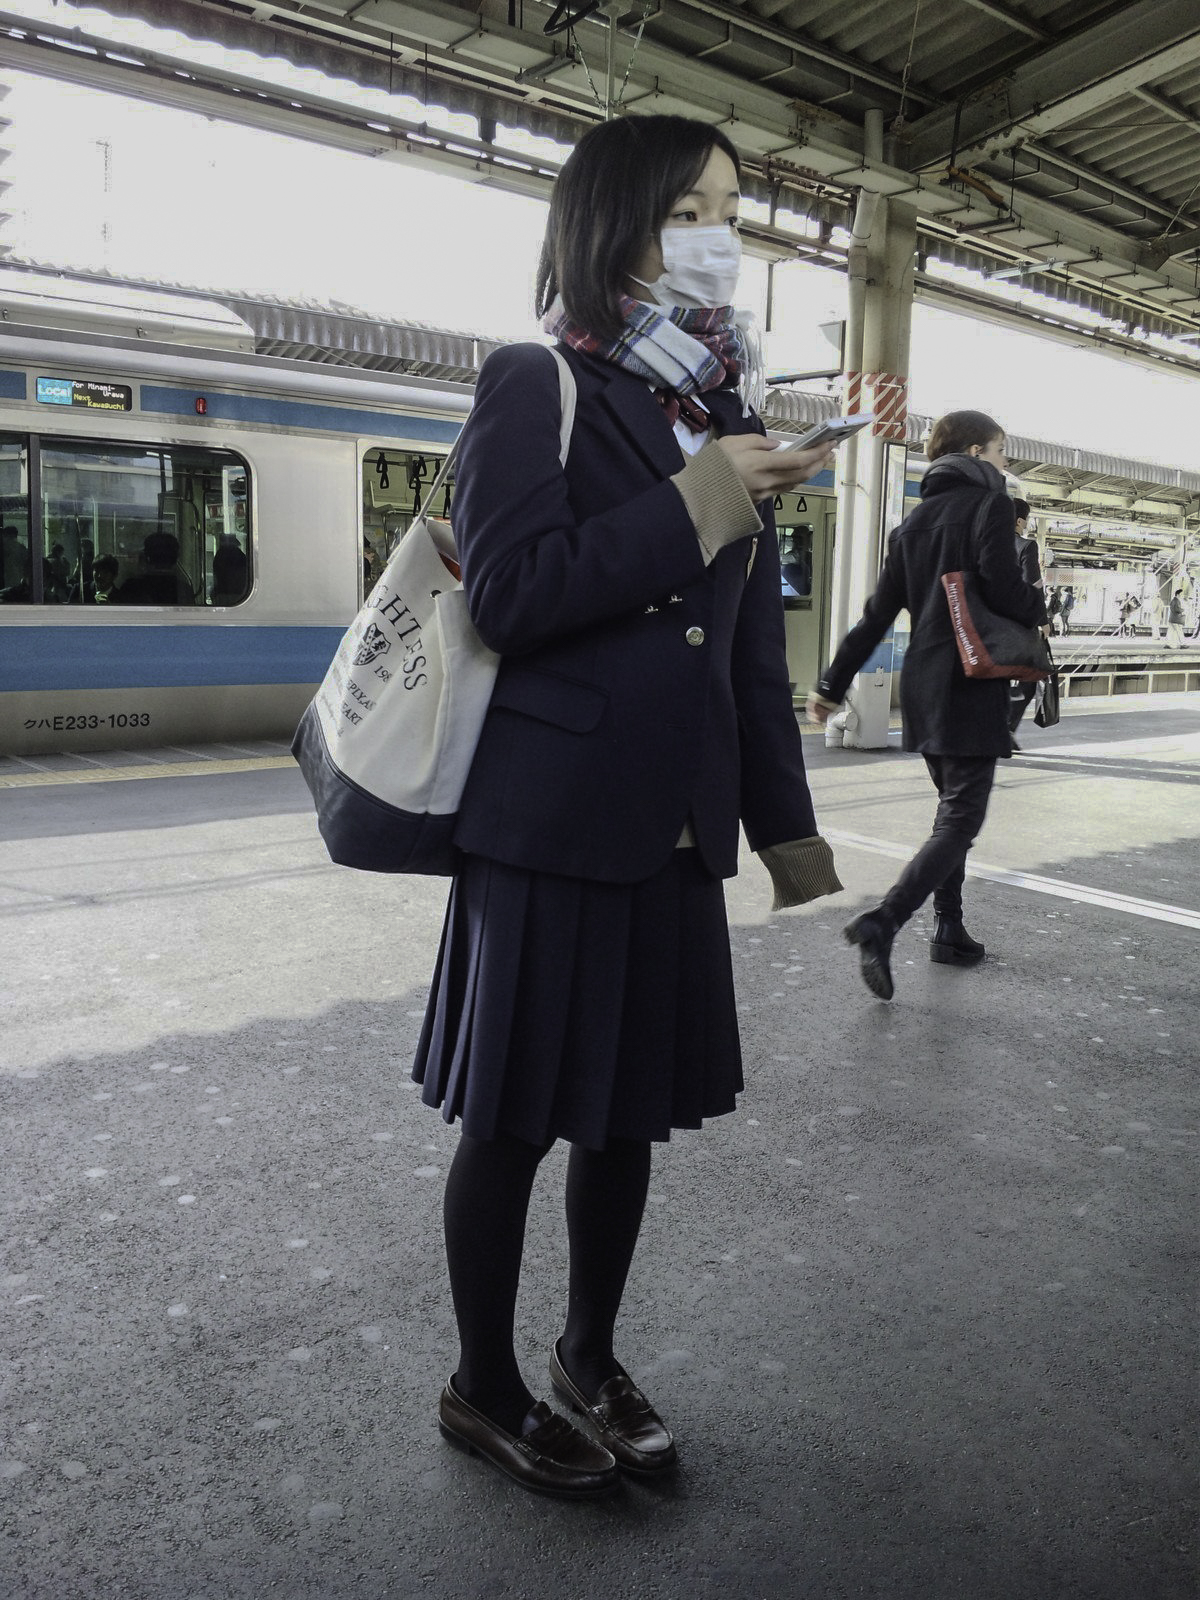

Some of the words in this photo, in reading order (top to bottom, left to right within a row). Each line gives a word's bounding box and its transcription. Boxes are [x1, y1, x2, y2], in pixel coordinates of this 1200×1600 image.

[37, 384, 71, 397] Local
[72, 381, 84, 389] for
[87, 383, 116, 392] Minami-
[73, 393, 91, 401] Next
[102, 391, 125, 399] Urawa
[87, 400, 125, 411] Kawaguchi
